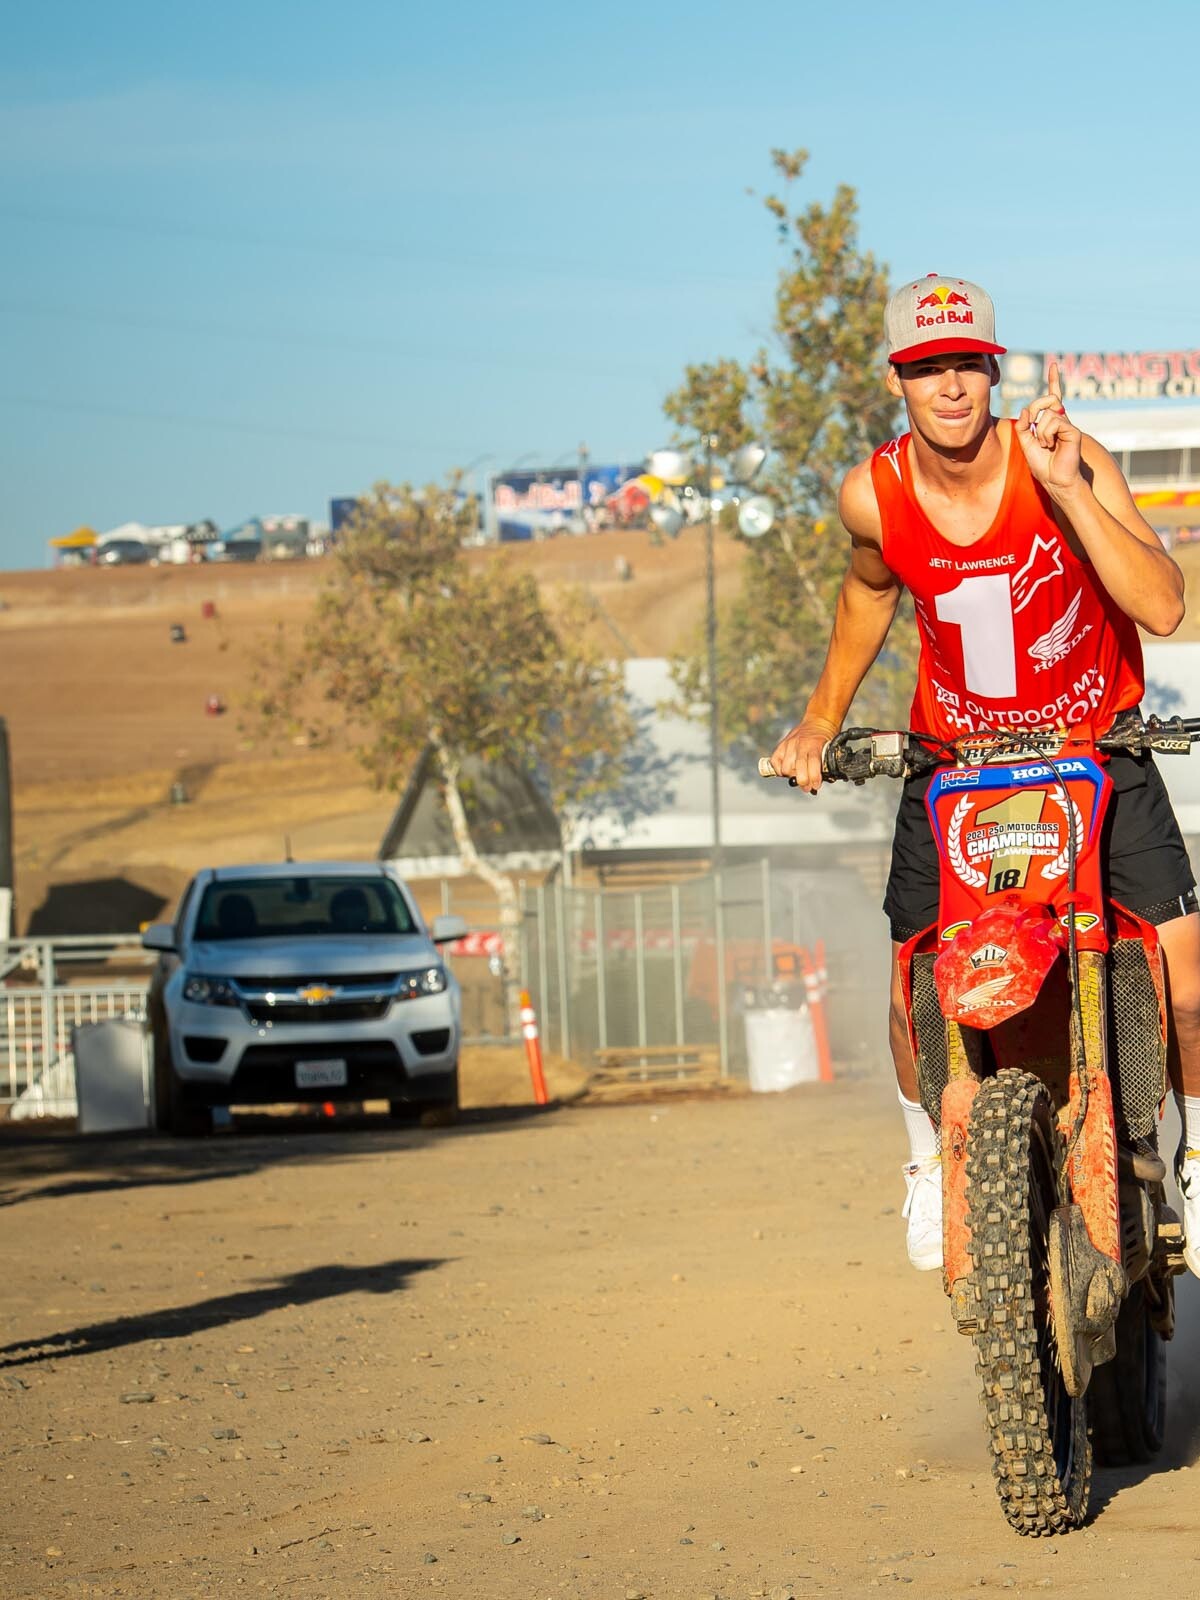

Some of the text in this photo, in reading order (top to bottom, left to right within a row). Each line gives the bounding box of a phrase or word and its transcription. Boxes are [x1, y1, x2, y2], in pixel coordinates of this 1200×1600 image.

[915, 310, 974, 328] Red Bull
[929, 553, 1016, 571] JETT LAWRENCE
[934, 573, 1017, 699] 1
[1033, 624, 1094, 675] HONDA
[944, 675, 1105, 734] HAION
[965, 693, 1071, 724] OUTDOOR
[1072, 664, 1099, 696] MX
[1151, 739, 1190, 750] ARC
[940, 769, 981, 790] HRC
[1012, 761, 1087, 780] HONDA
[966, 823, 1059, 841] 2021 250 MOTOCROSS
[973, 788, 1048, 896] 1
[966, 832, 1060, 857] CHAMPION
[968, 847, 1059, 865] JETT LAWRENCE
[993, 868, 1021, 893] 18
[957, 999, 1017, 1015] HONDA
